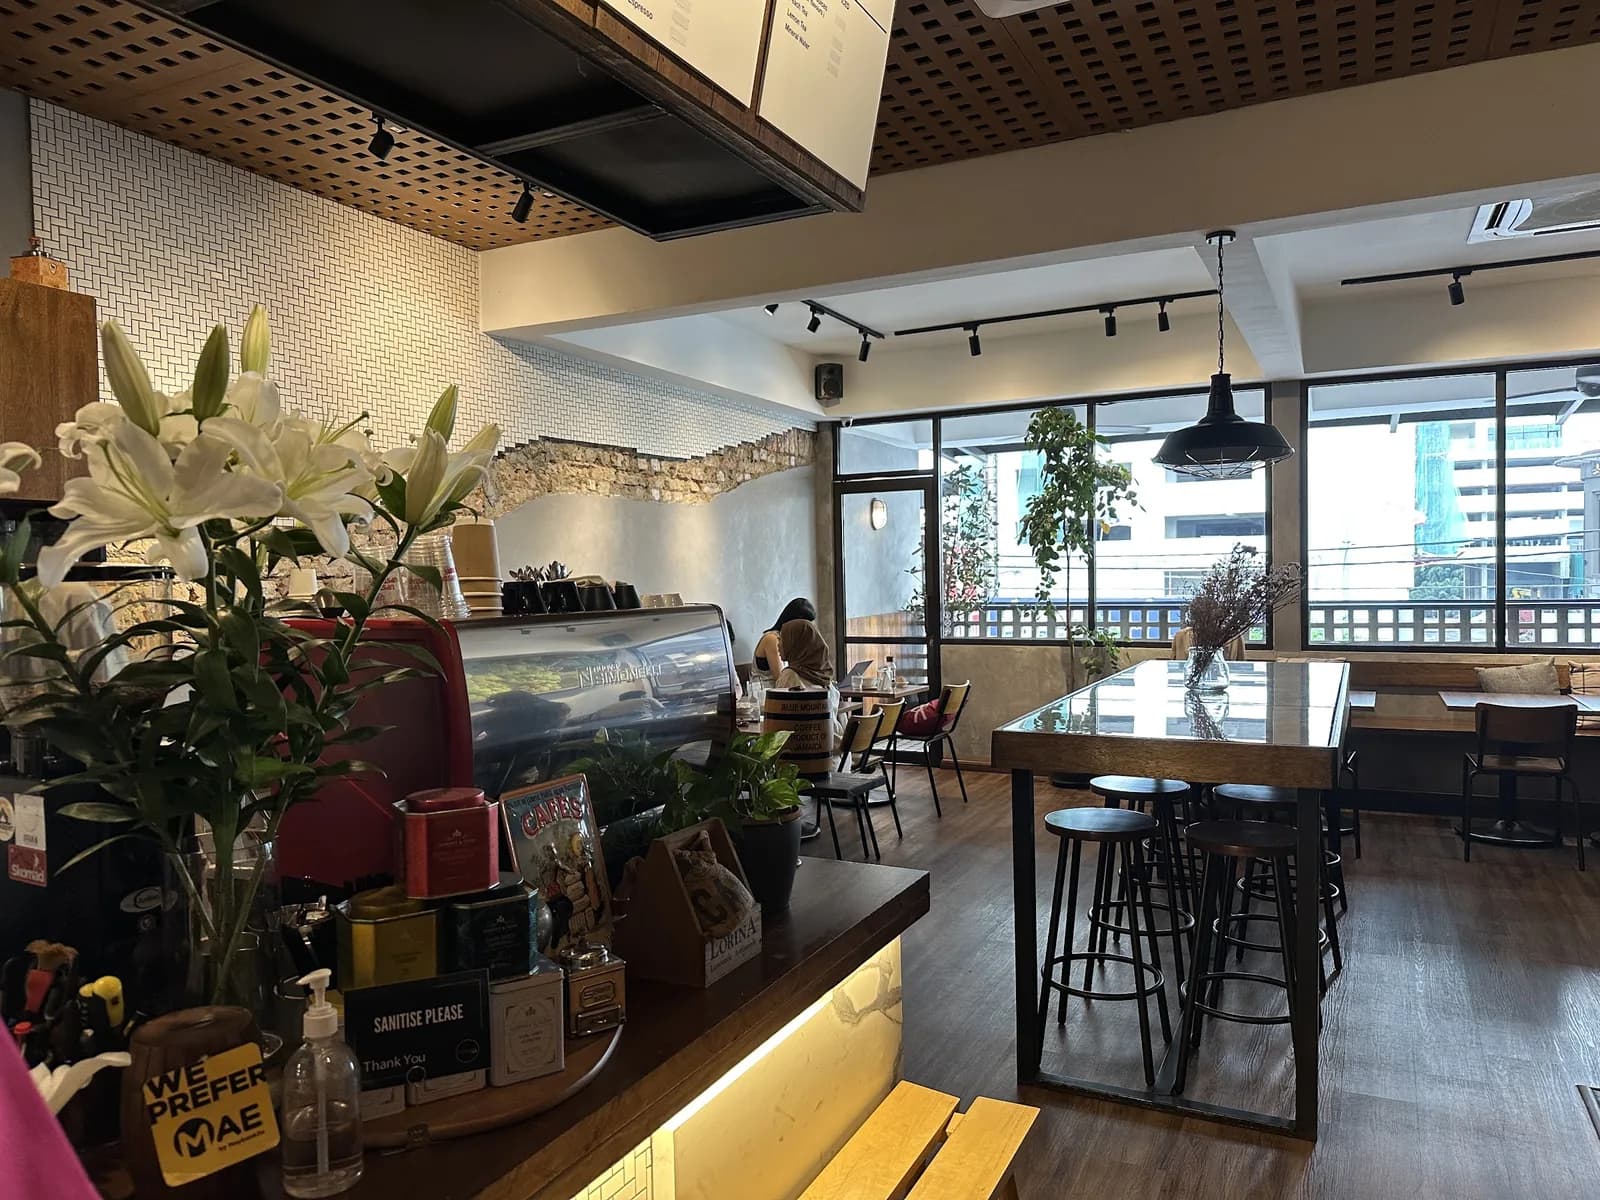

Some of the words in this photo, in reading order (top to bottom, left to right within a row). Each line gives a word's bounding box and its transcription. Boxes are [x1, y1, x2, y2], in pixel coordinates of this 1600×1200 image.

[373, 1009, 424, 1034] SANITISE
[425, 1003, 465, 1025] PLEASE
[147, 1061, 207, 1098] WE
[363, 1056, 402, 1073] Thank
[403, 1053, 427, 1065] You
[147, 1064, 266, 1124] PREFER
[174, 1104, 263, 1158] MAE
